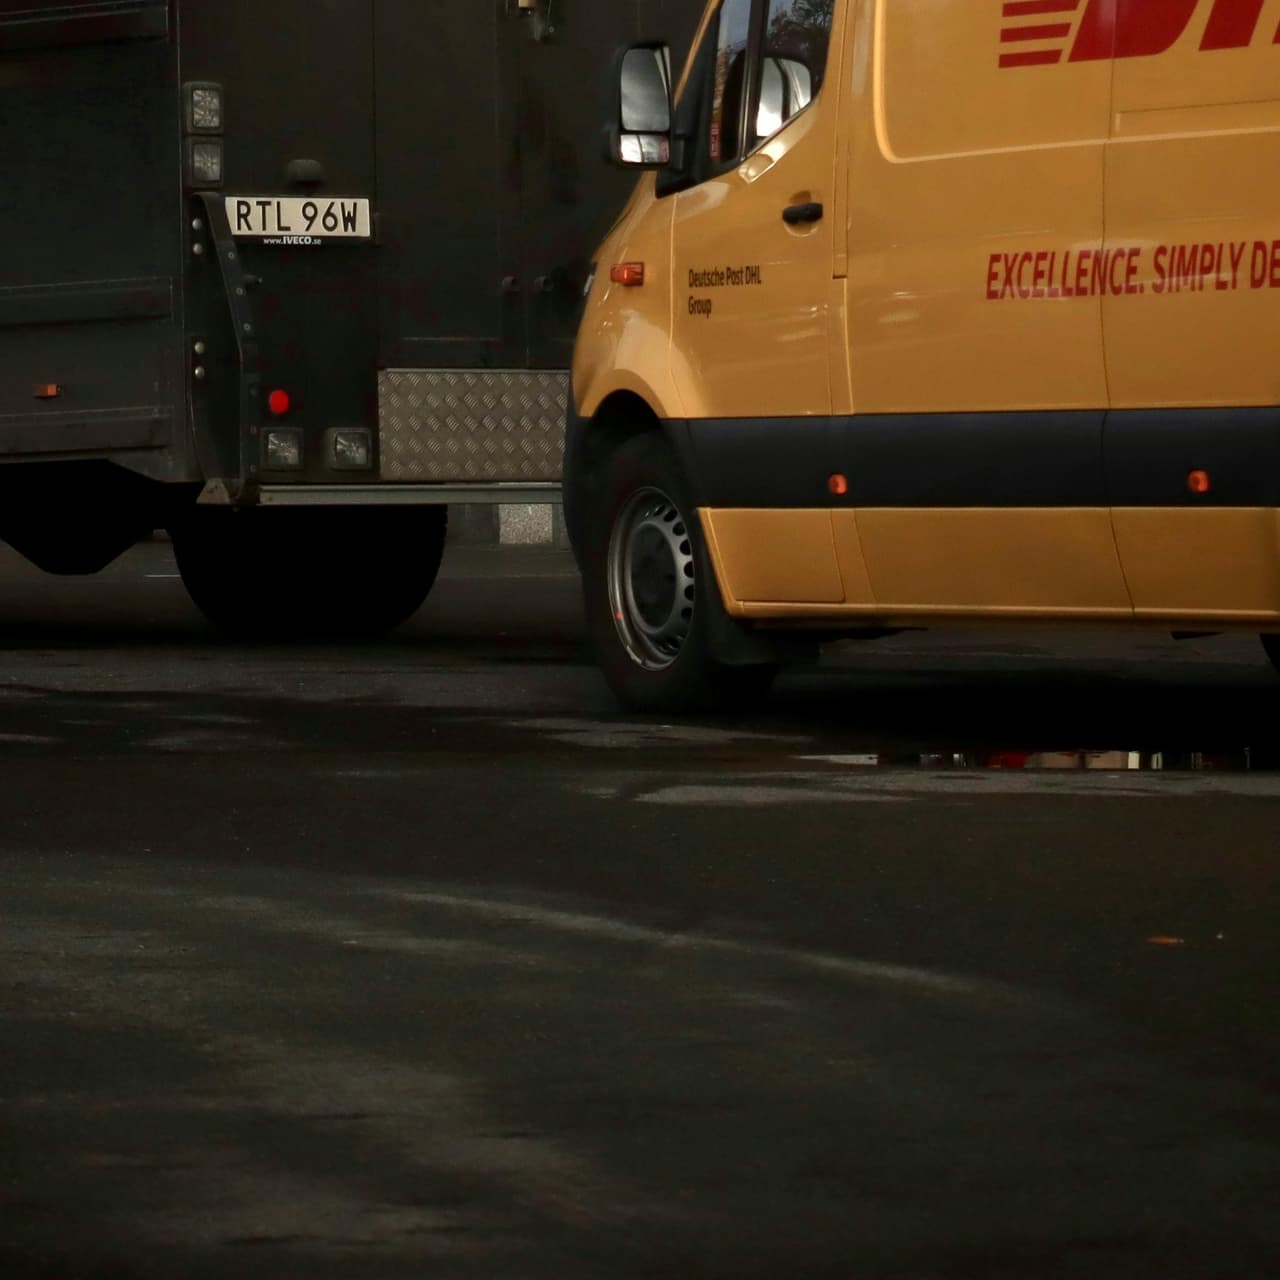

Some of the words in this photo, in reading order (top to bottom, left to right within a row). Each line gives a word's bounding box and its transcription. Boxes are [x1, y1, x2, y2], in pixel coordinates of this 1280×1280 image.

[236, 200, 292, 232] RTL
[301, 201, 357, 232] 96W
[688, 267, 725, 288] Deutsche
[726, 266, 744, 286] Post
[745, 265, 762, 285] DHL
[985, 247, 1145, 300] EXCELLENCE.
[1151, 241, 1246, 294] SIMPLY
[688, 295, 712, 319] Group
